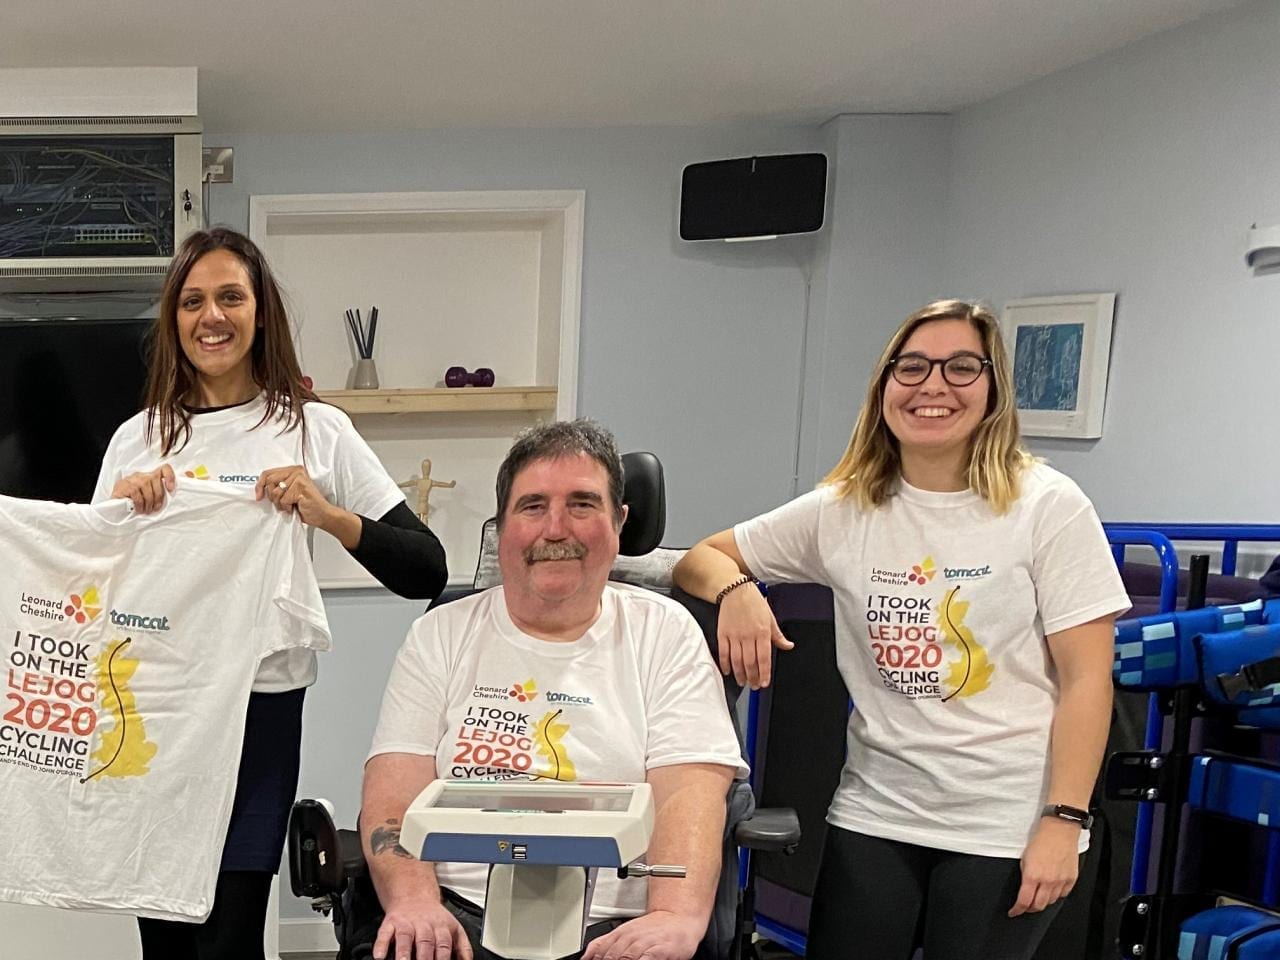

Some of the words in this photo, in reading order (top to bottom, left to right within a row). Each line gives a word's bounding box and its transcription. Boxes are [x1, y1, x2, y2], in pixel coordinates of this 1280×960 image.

[218, 474, 259, 483] tomca
[870, 575, 909, 586] Cheshire
[872, 568, 907, 578] Leonard
[944, 565, 992, 578] tomcat
[21, 592, 64, 610] Leonard
[868, 595, 872, 608] I
[878, 596, 932, 611] TOOK
[20, 604, 64, 622] Cheshire
[110, 609, 170, 631] tomcat
[866, 610, 890, 623] ON
[896, 612, 930, 624] THE
[868, 624, 936, 642] LEJOG
[14, 630, 21, 647] I
[28, 634, 90, 661] TOOK
[10, 651, 42, 671] ON
[48, 658, 88, 678] THE
[872, 643, 942, 668] 2020
[878, 668, 939, 684] CYCLING
[8, 669, 96, 702] LEJOG
[474, 684, 508, 694] Leonard
[884, 680, 941, 695] CLENGE
[473, 692, 508, 700] Cheshire
[546, 691, 593, 704] tomcat
[3, 693, 97, 736] 2020
[467, 706, 472, 716] I
[478, 708, 530, 724] TOOK
[464, 718, 489, 728] ON
[495, 721, 527, 736] THE
[0, 726, 88, 756] CYCLING
[458, 727, 532, 750] LEJOG
[452, 742, 532, 772] 2020
[452, 766, 520, 778] CYCLI
